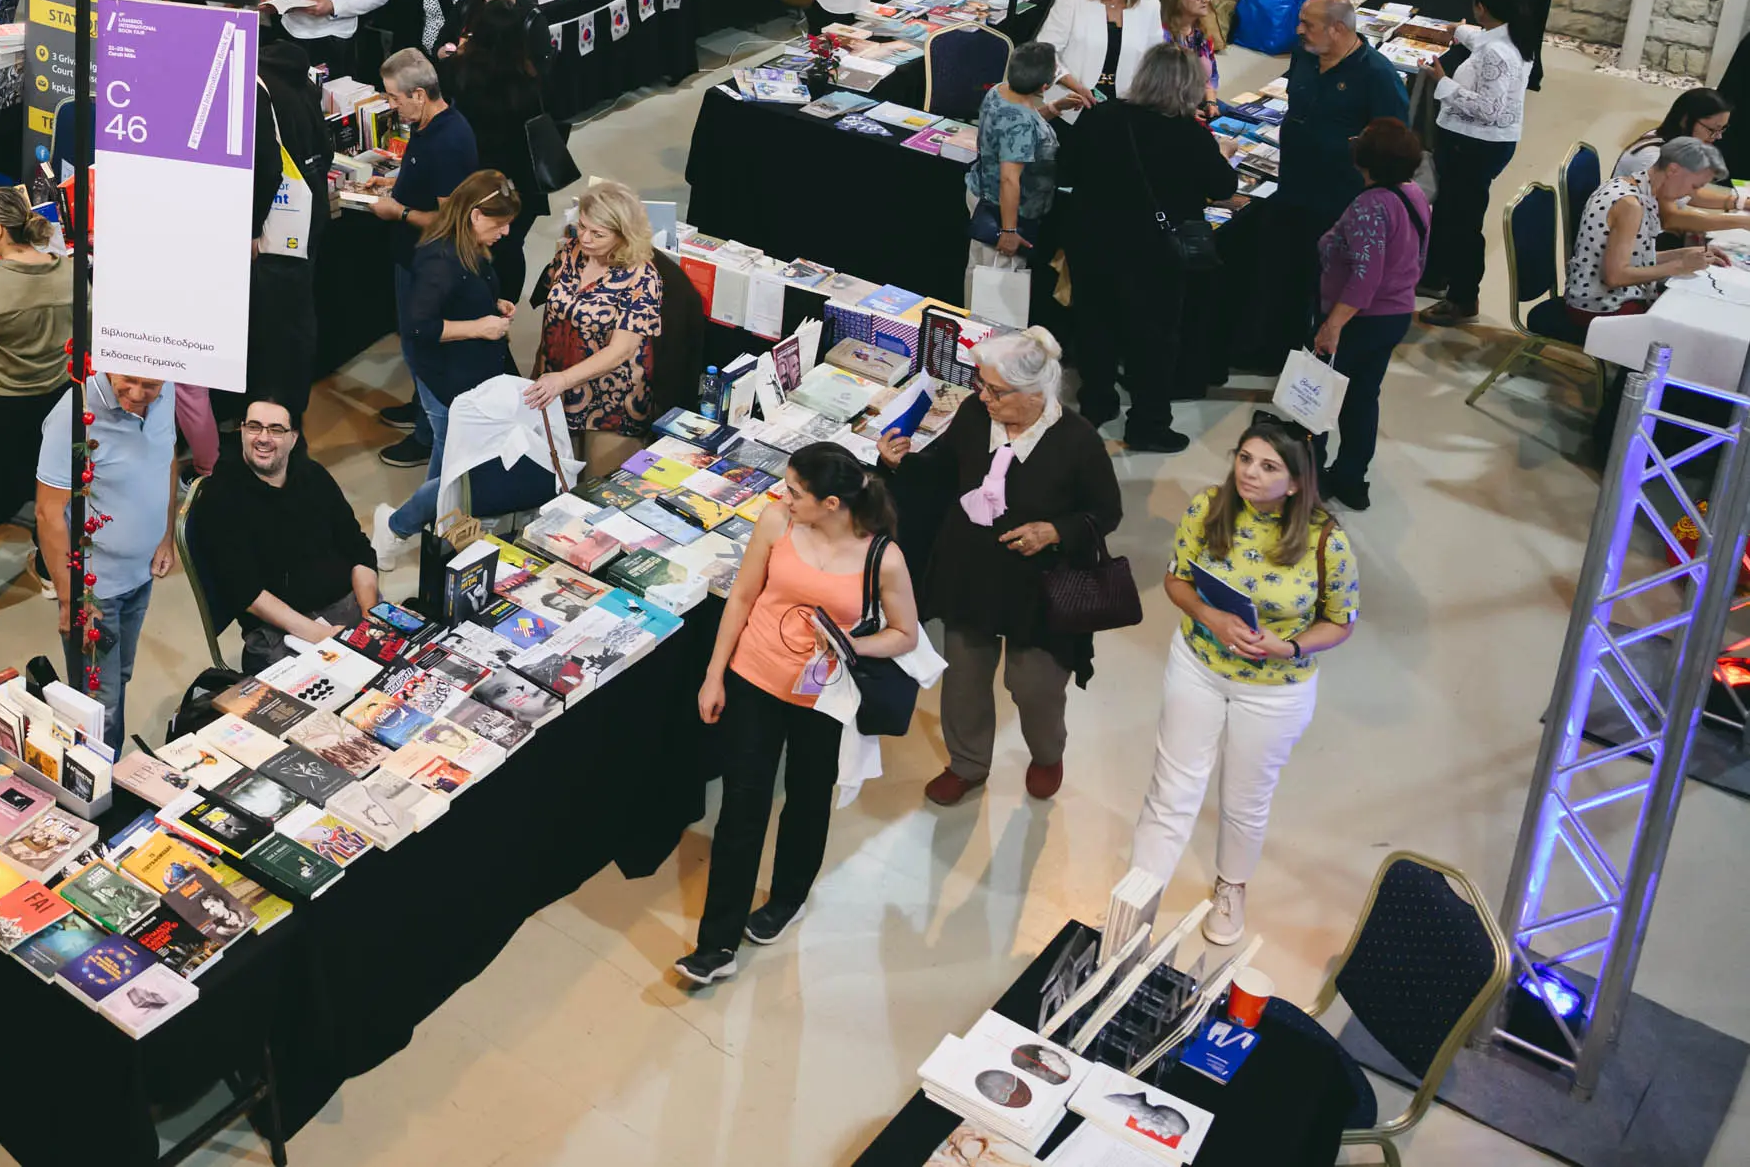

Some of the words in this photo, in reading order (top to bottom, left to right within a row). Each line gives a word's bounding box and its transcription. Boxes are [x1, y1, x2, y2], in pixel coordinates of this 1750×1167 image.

[52, 65, 74, 78] Court
[203, 58, 223, 104] International
[106, 80, 131, 109] C
[104, 114, 148, 144] 46
[101, 327, 162, 343] Βιβλιοπωλείο
[100, 348, 142, 363] Εκδόσεις
[143, 355, 187, 370] Γερμανός
[23, 891, 55, 914] FAI
